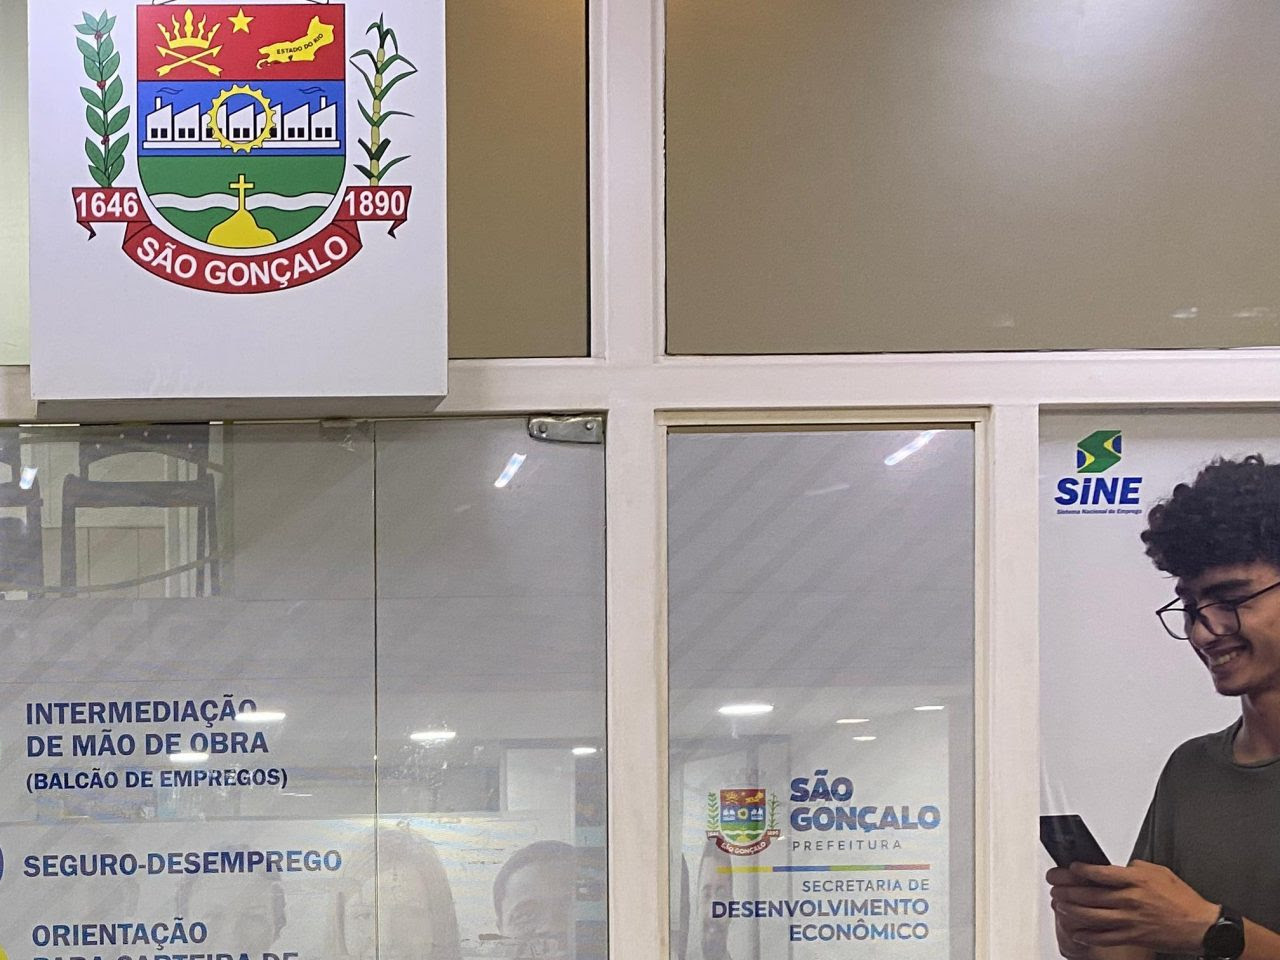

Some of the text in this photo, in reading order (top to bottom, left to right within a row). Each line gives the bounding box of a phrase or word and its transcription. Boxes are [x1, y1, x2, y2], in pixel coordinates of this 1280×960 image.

[75, 191, 139, 218] 1646
[344, 190, 406, 217] 1890
[136, 235, 348, 288] SÃO GONÇALO
[27, 729, 269, 757] DE MÃO DE OBRA
[27, 768, 288, 791] (BALCÃO DE EMPREGOS)
[790, 769, 854, 802] SÃO
[790, 805, 941, 833] GONÇALO
[792, 840, 902, 851] PREFEITURA
[23, 849, 343, 877] SEGURO-DESEMPREGO
[802, 879, 930, 893] SECRETARIA DE
[712, 899, 930, 919] DESENVOLVIMENTO
[32, 917, 208, 950] ORIENTAÇÃO
[789, 918, 930, 942] ECONÔMICO
